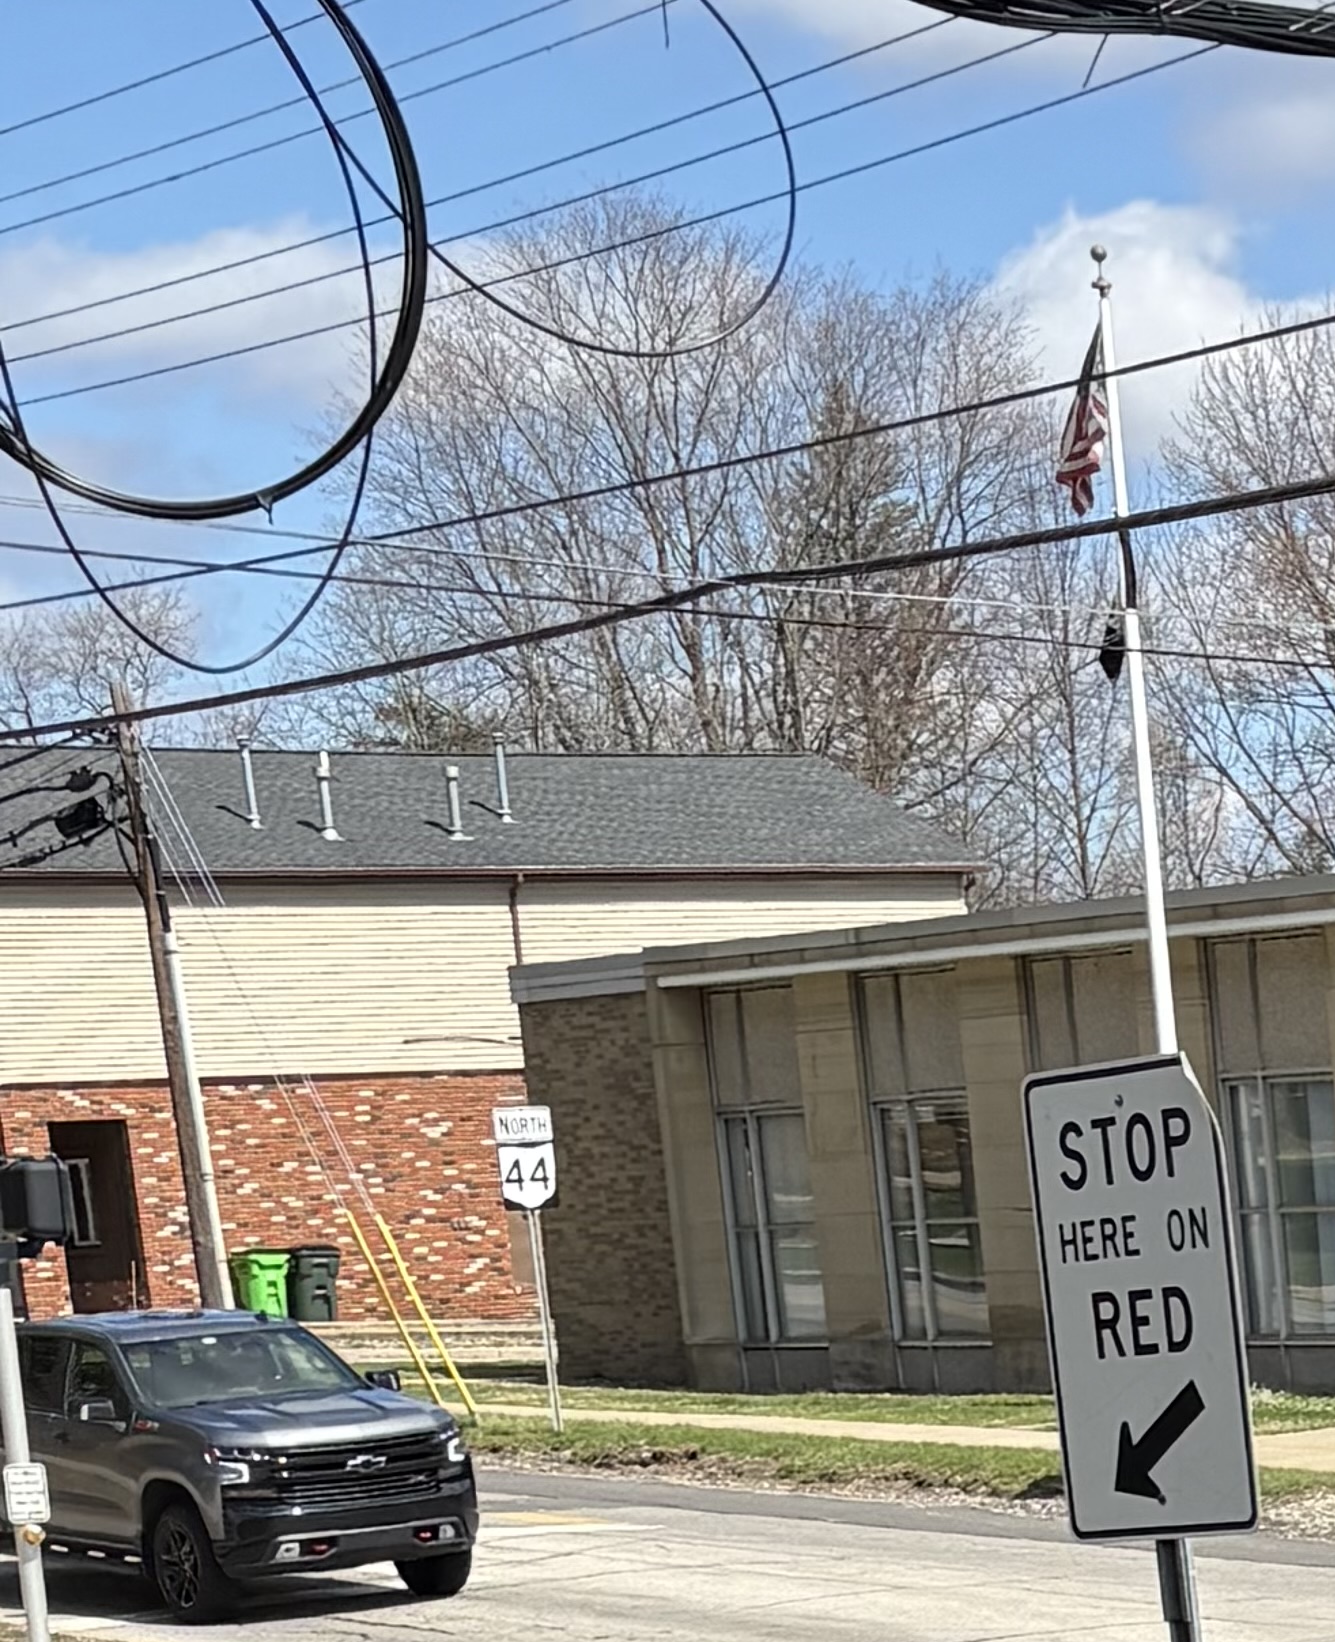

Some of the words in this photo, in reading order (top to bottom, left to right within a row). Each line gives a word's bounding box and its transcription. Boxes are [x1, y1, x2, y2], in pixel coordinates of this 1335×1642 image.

[499, 1116, 547, 1135] NORTH
[1058, 1106, 1192, 1191] STOP
[504, 1156, 550, 1191] 44
[1058, 1215, 1141, 1264] HERE
[1167, 1206, 1210, 1252] ON
[1091, 1286, 1194, 1359] RED
